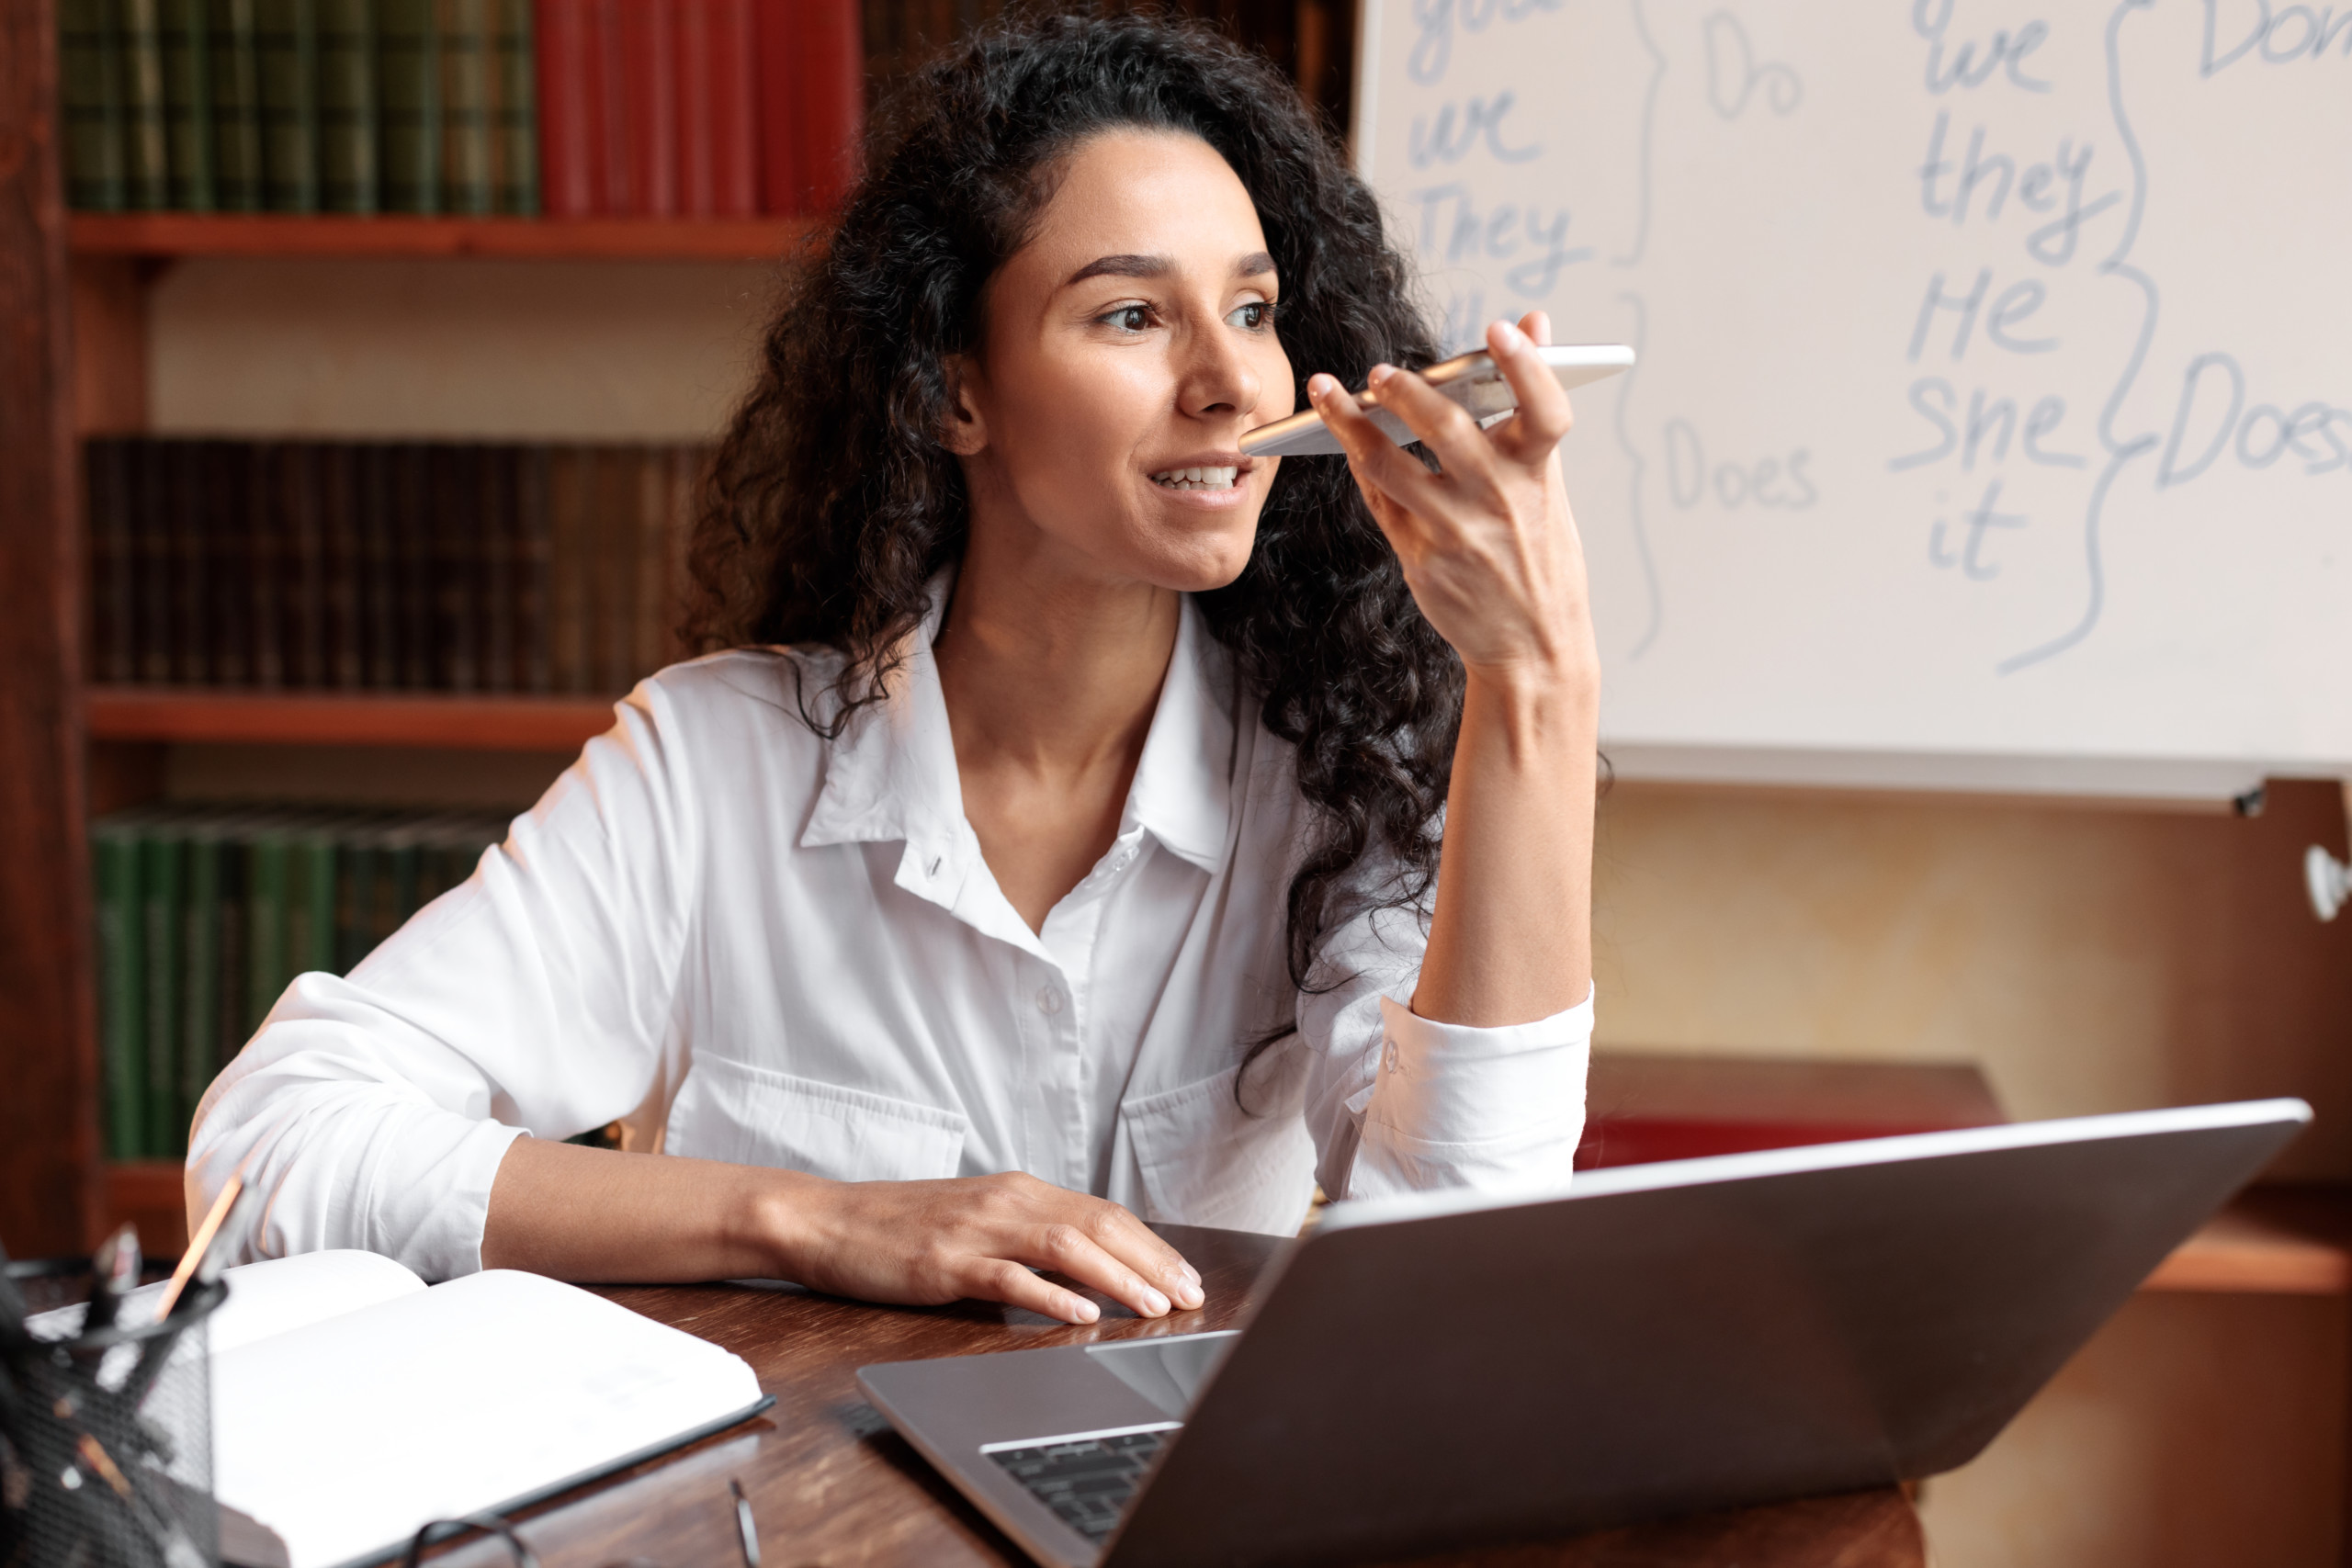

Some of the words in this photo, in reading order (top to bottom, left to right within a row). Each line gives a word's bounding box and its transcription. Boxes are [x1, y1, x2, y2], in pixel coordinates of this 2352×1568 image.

[1702, 8, 1804, 121] Do
[1924, 17, 2054, 96] we
[1407, 90, 1545, 170] we
[1916, 107, 2123, 267] they
[1411, 184, 1596, 299] They
[1905, 266, 2062, 364] He
[1664, 417, 1819, 511] Does
[1928, 478, 2029, 582] it
